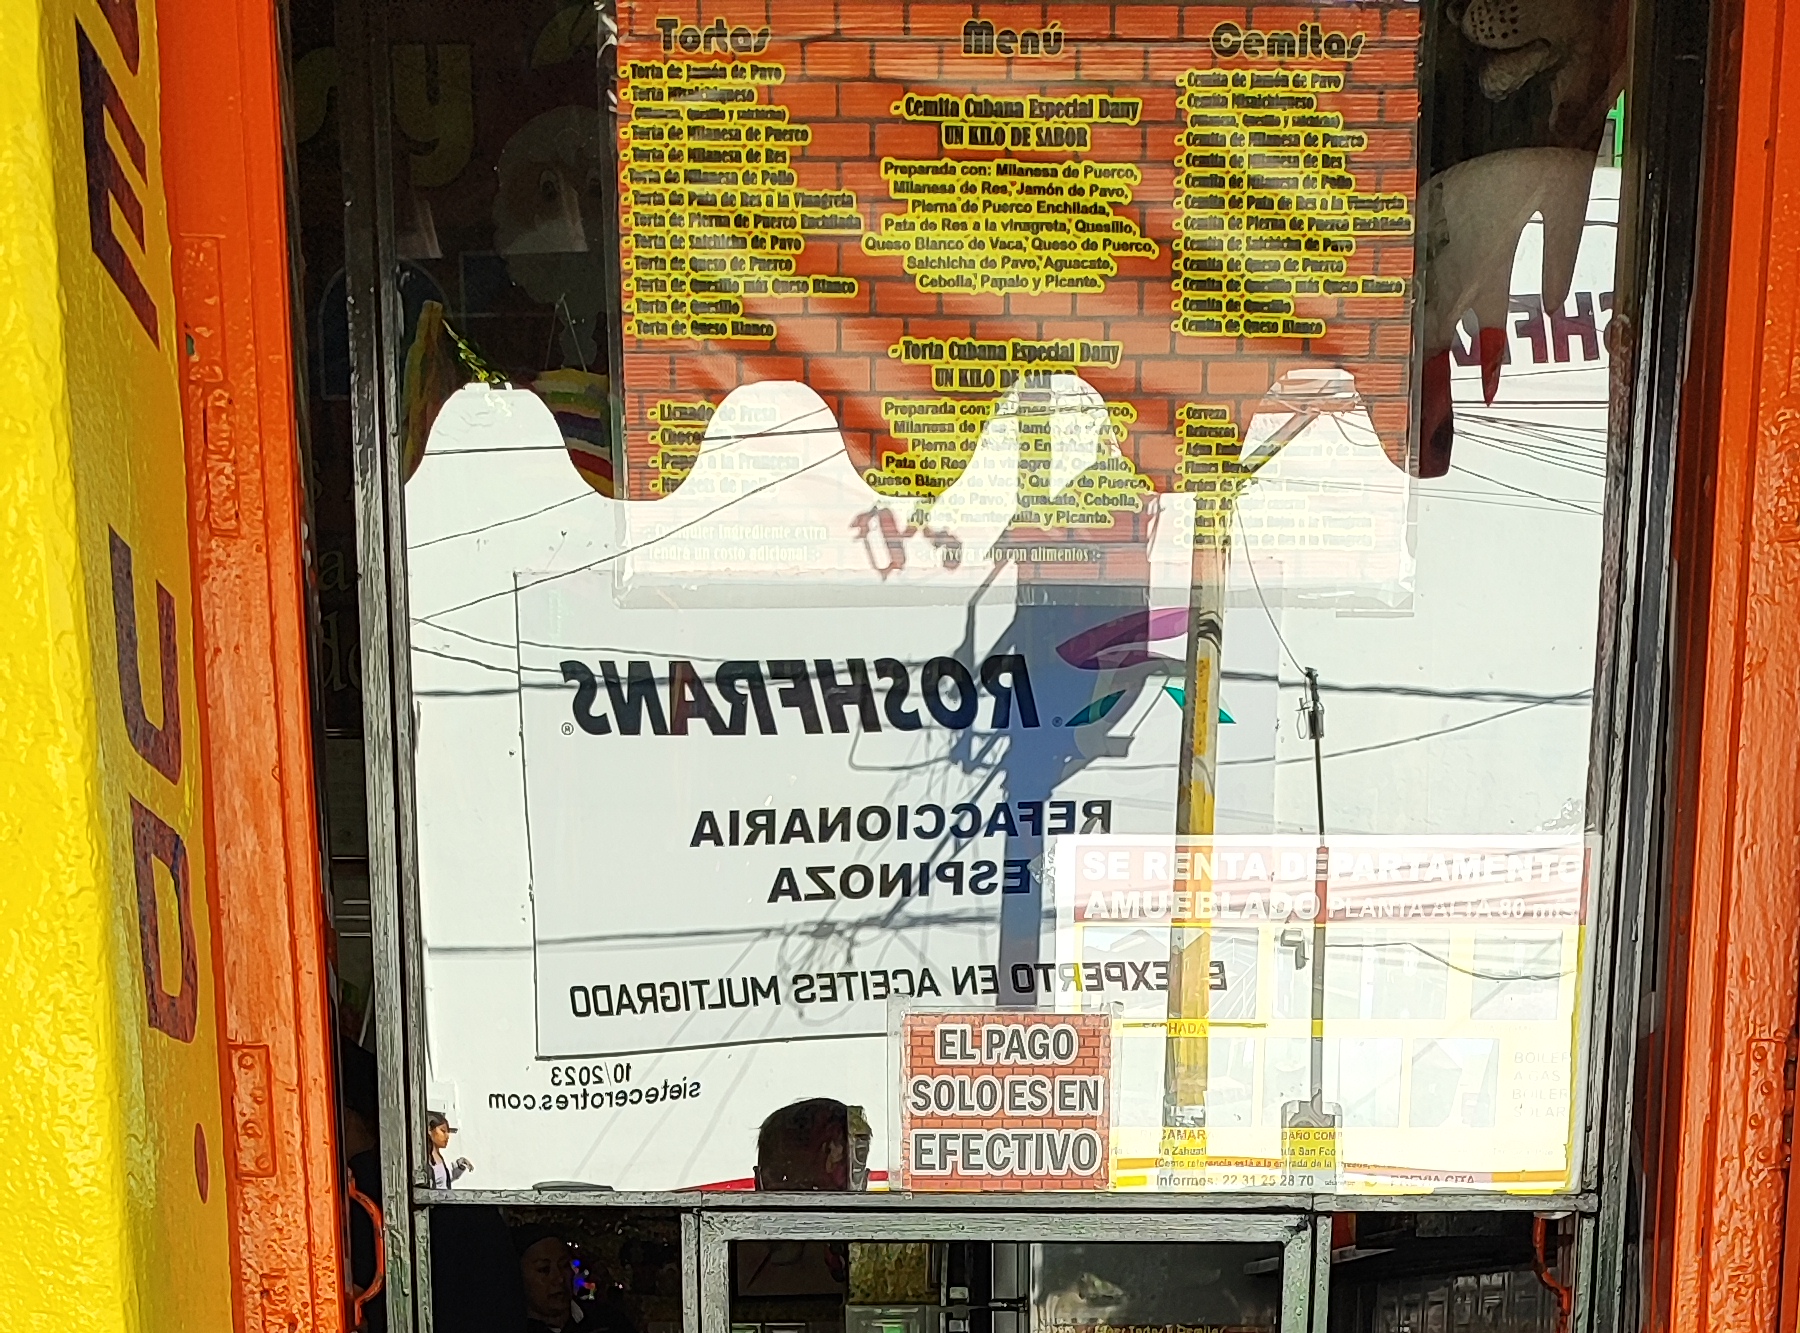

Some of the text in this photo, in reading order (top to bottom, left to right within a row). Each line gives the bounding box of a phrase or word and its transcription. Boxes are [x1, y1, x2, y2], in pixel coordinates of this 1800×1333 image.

[655, 18, 770, 53] Tortas
[962, 20, 1064, 55] Menú
[1211, 22, 1365, 58] Cemitas
[904, 97, 1140, 121] Cemita Cubana Especial Dany
[668, 125, 683, 140] de
[745, 126, 761, 141] de
[944, 126, 1088, 147] UN KILO DE SABOR
[884, 161, 1138, 181] Preparada con: Milanesa de Puerco,
[894, 180, 956, 194] Milanesa
[960, 181, 977, 194] de
[981, 181, 1012, 197] Res,
[1016, 183, 1064, 197] Jamón
[1068, 184, 1085, 197] de
[911, 199, 1110, 217] Pierna de Puerco Enchilada,
[669, 212, 685, 228] de
[734, 213, 750, 228] de
[884, 218, 916, 231] Pata
[919, 218, 937, 231] de
[941, 218, 968, 231] Res
[972, 222, 980, 231] a
[984, 218, 997, 231] la
[1075, 219, 1137, 236] Quesillo,
[865, 236, 1155, 255] Queso Blanco de Vaca, Queso de Puerco,
[906, 256, 1114, 272] Salchicha de Pavo, Aguacate,
[919, 274, 977, 291] Cebolla,
[1032, 277, 1041, 291] y
[1045, 275, 1101, 288] Picante.
[903, 340, 1120, 364] Torta Cubana Especial Dany
[935, 368, 1019, 389] UN KILO DE
[885, 455, 916, 469] Pata
[919, 456, 937, 469] de
[1098, 475, 1151, 491] Puerco,
[1083, 492, 1140, 509] Cebolla,
[1056, 511, 1111, 524] Picante.
[1031, 546, 1090, 562] alimentos
[1082, 851, 1131, 881] SE
[1142, 850, 1268, 882] RENTA
[1082, 890, 1322, 920] AMUEBLADO
[1328, 896, 1427, 918] PLANTA
[939, 1028, 1075, 1061] EL PAGO
[911, 1079, 1099, 1112] SOLO ES EN
[913, 1133, 1098, 1171] EFECTIVO
[1222, 1174, 1236, 1187] 22
[1242, 1174, 1256, 1187] 31
[1279, 1174, 1295, 1187] 28
[1298, 1174, 1314, 1187] 70
